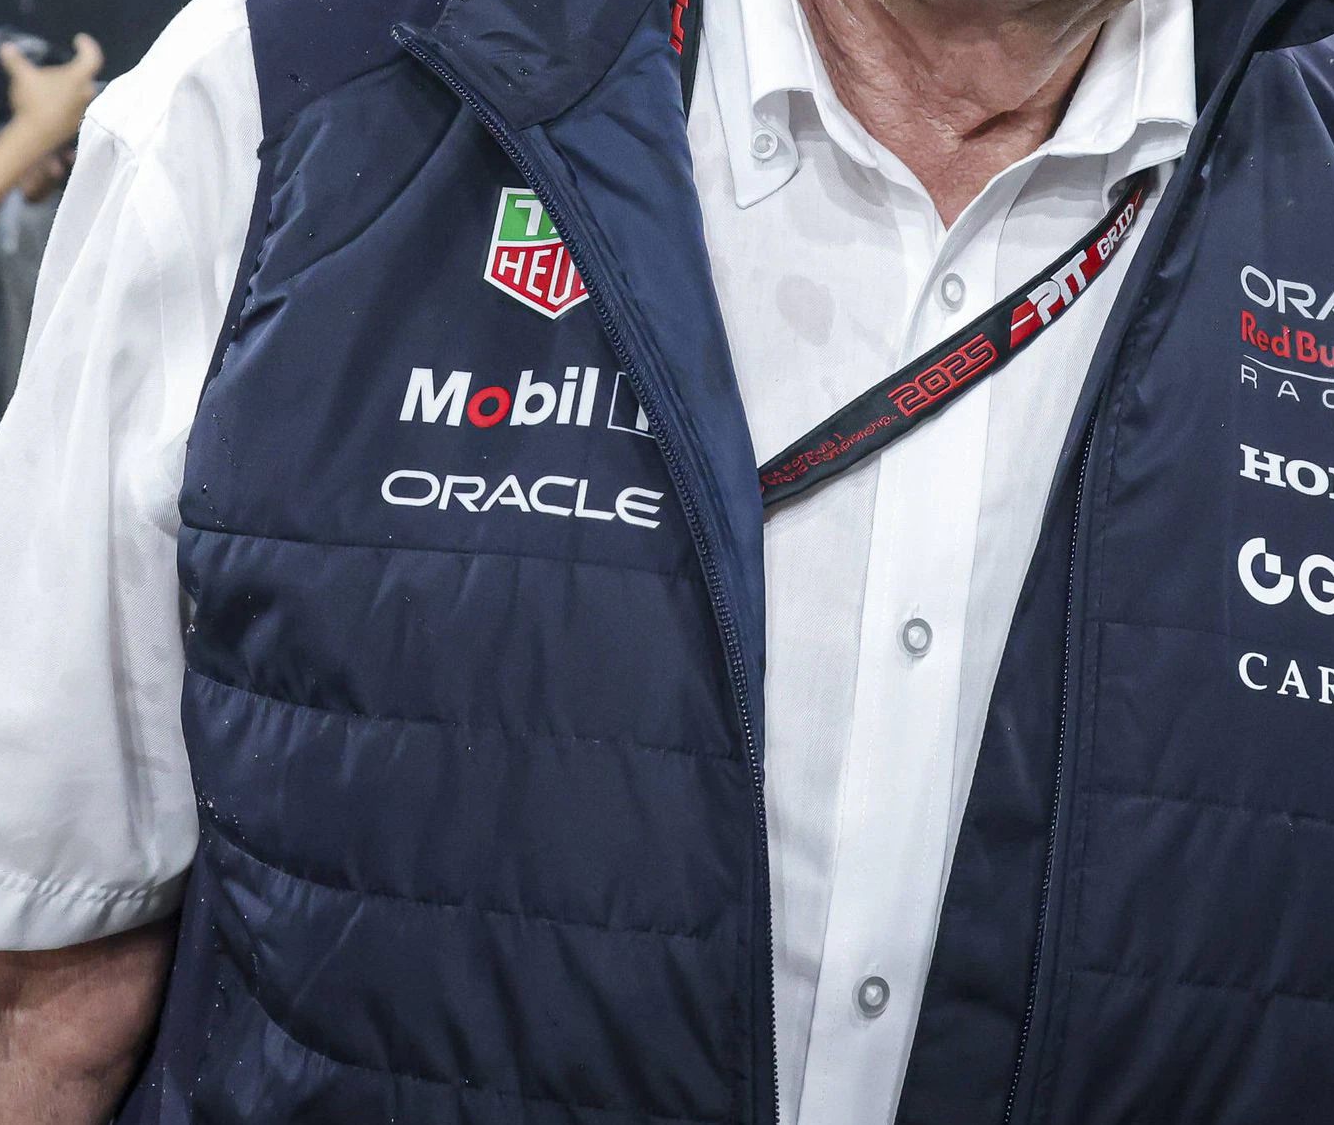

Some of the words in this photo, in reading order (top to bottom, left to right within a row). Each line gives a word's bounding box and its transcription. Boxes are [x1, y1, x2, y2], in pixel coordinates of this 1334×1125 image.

[498, 246, 586, 306] HEU
[1027, 250, 1088, 326] PIT
[1097, 203, 1135, 262] GRID
[1241, 310, 1292, 359] Red
[399, 366, 600, 428] Mobil
[887, 333, 998, 417] 2025
[381, 470, 665, 528] ORACLE
